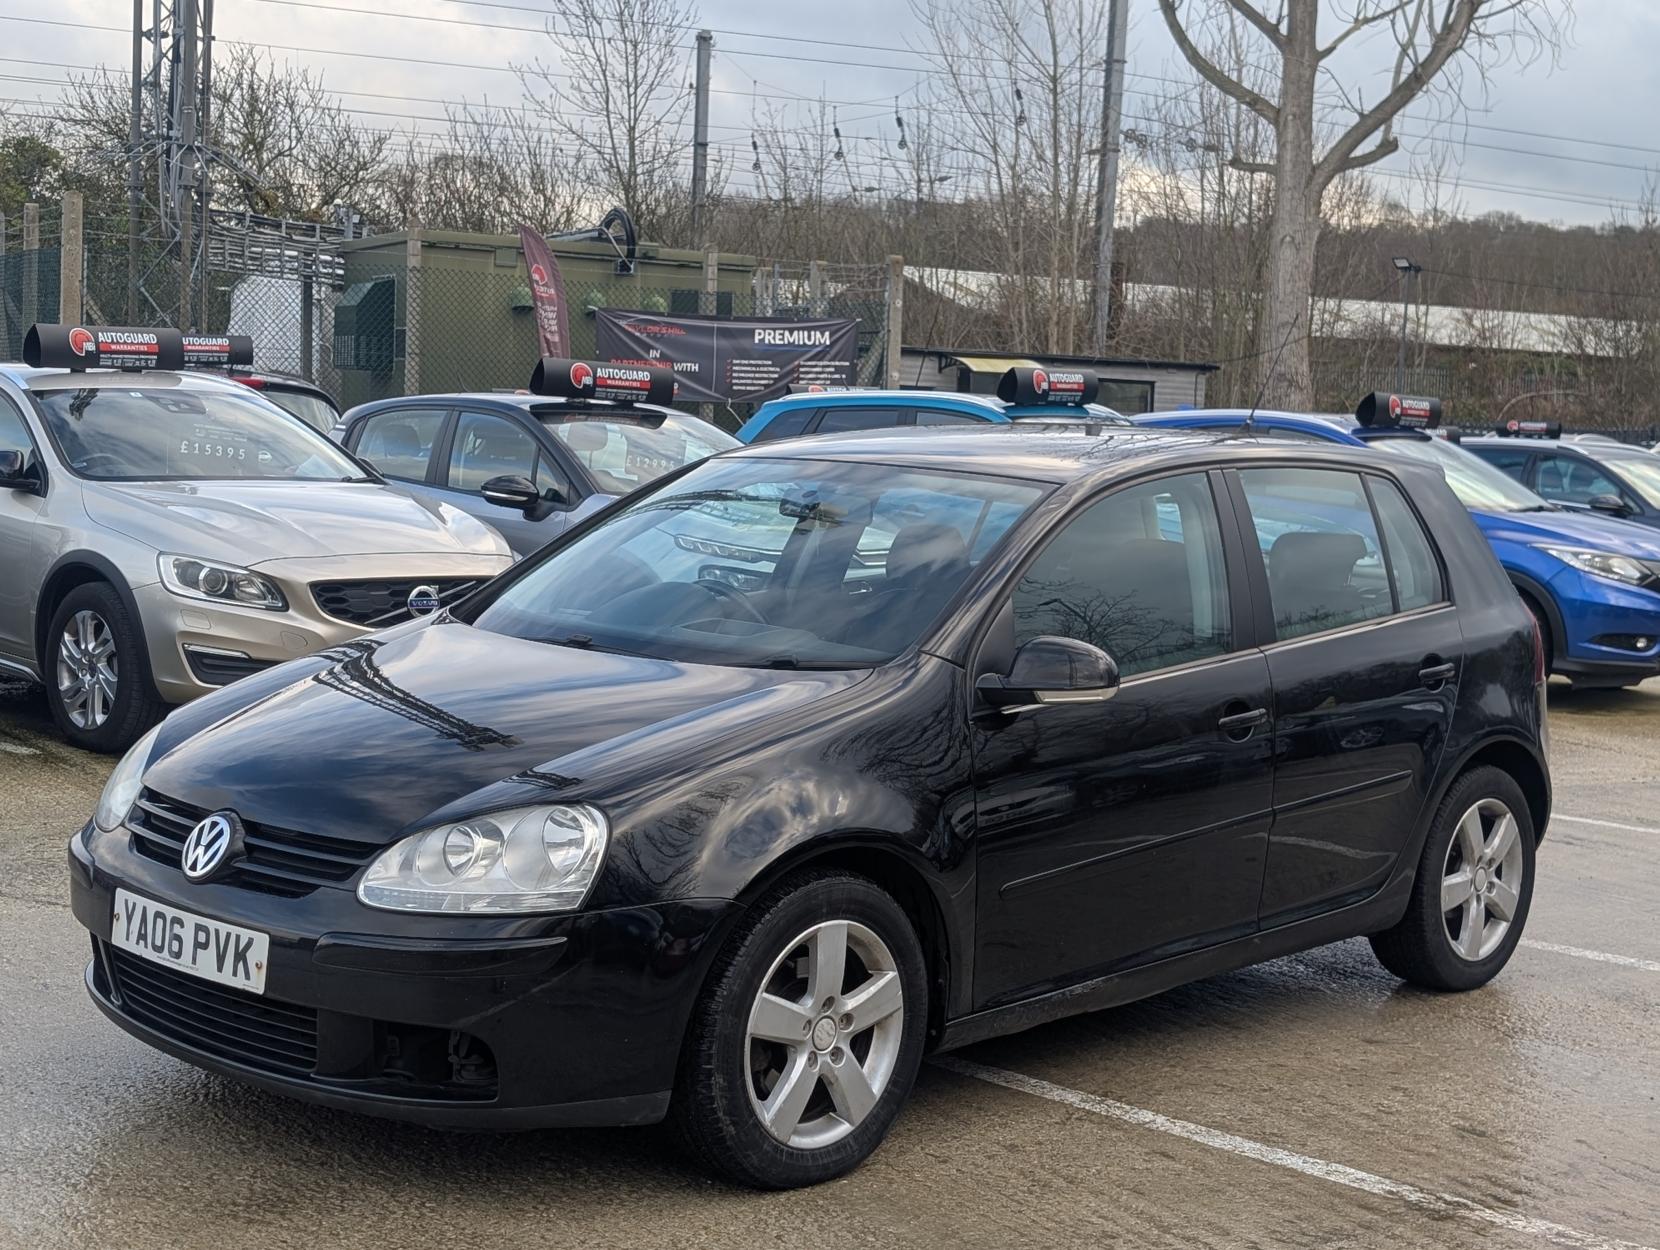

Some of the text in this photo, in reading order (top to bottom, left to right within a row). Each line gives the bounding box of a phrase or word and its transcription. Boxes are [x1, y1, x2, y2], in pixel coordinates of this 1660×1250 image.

[98, 331, 158, 344] AUTOGUARD
[182, 336, 230, 346] UTOGUARD
[754, 329, 831, 345] PREMIUM
[110, 344, 149, 352] WARRANTIES
[649, 349, 661, 359] IN
[673, 362, 700, 373] WITH
[596, 367, 651, 381] AUTOGUARD
[1048, 373, 1085, 383] AUTOGUARD
[606, 379, 641, 388] WARRANTIES
[1402, 399, 1431, 410] AUTOGUARD
[180, 440, 247, 460] £15395
[124, 898, 255, 982] YA06 PVK
